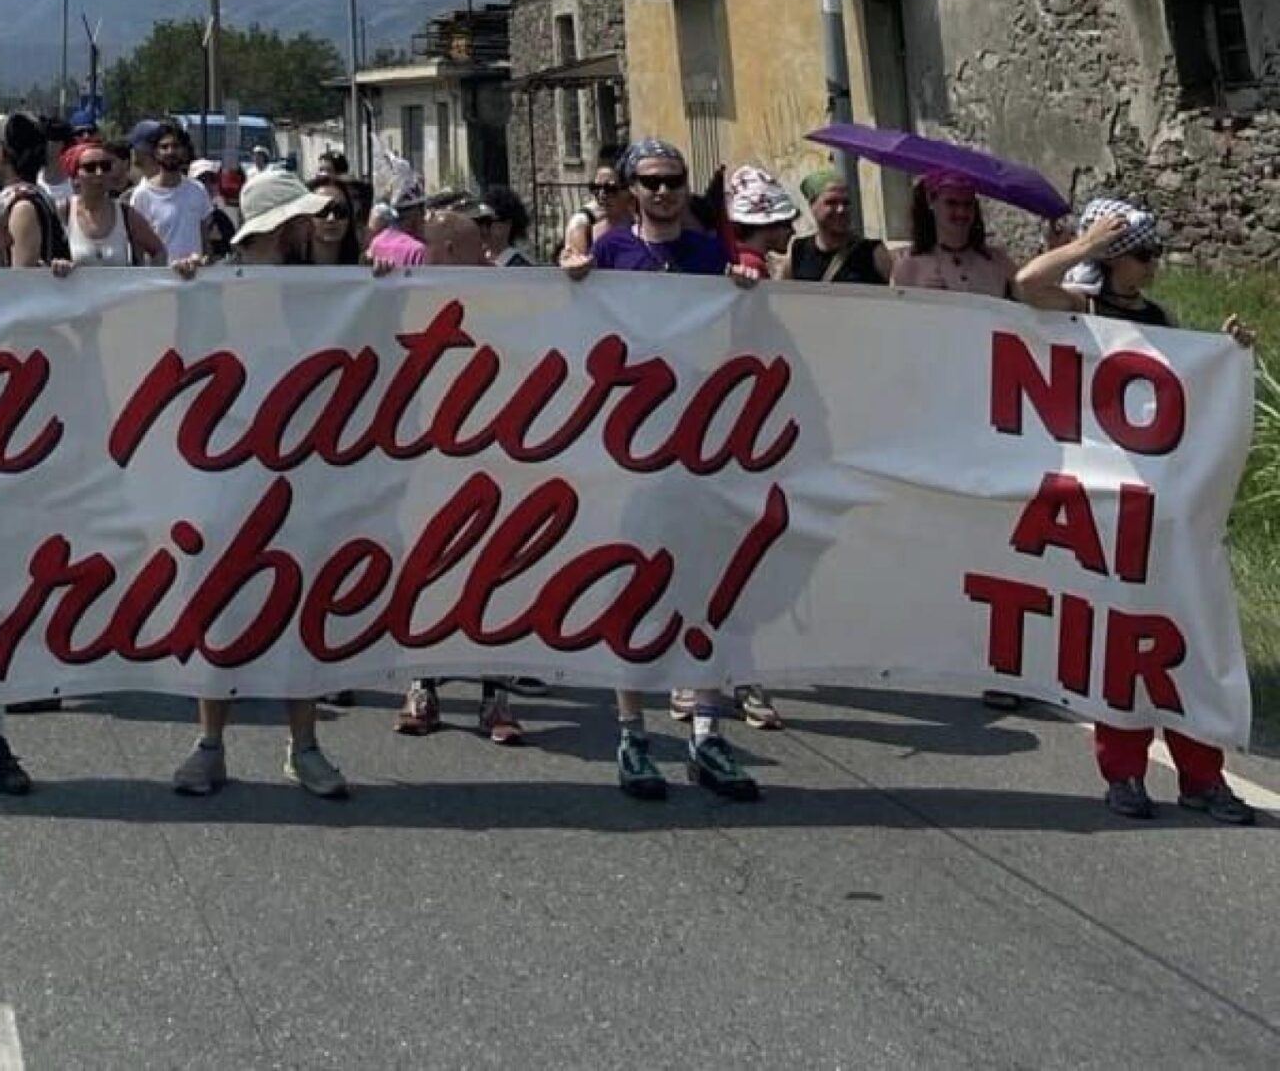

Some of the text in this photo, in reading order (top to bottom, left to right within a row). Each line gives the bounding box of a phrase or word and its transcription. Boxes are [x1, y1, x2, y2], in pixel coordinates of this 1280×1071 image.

[108, 299, 800, 475] natura
[990, 330, 1187, 456] NO
[1009, 472, 1155, 584] AI
[963, 572, 1187, 717] TIR
